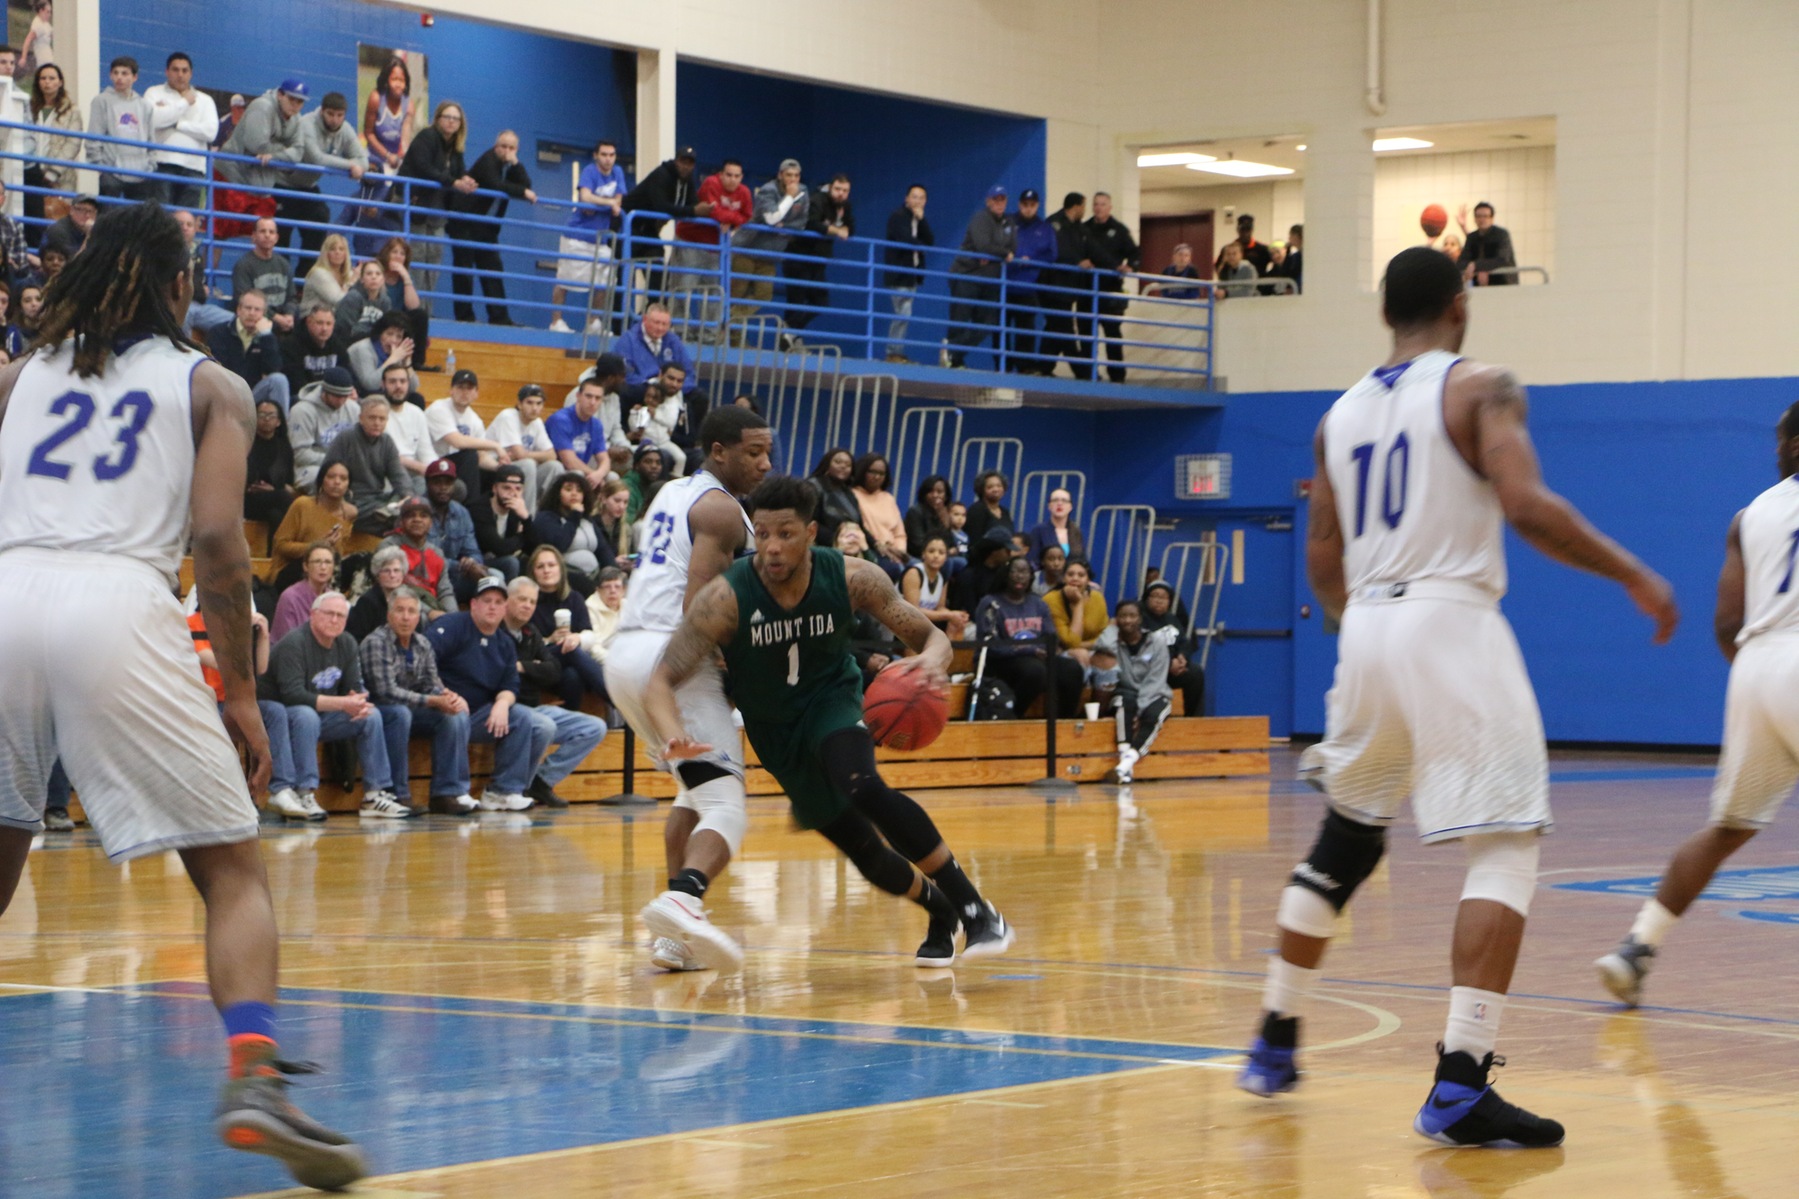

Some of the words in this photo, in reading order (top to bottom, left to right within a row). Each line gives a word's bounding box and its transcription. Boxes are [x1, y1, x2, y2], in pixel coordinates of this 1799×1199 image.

[26, 389, 155, 481] 23
[1351, 430, 1410, 538] 10
[750, 617, 803, 647] MOUNT
[809, 613, 835, 637] IDA
[786, 641, 800, 687] 1
